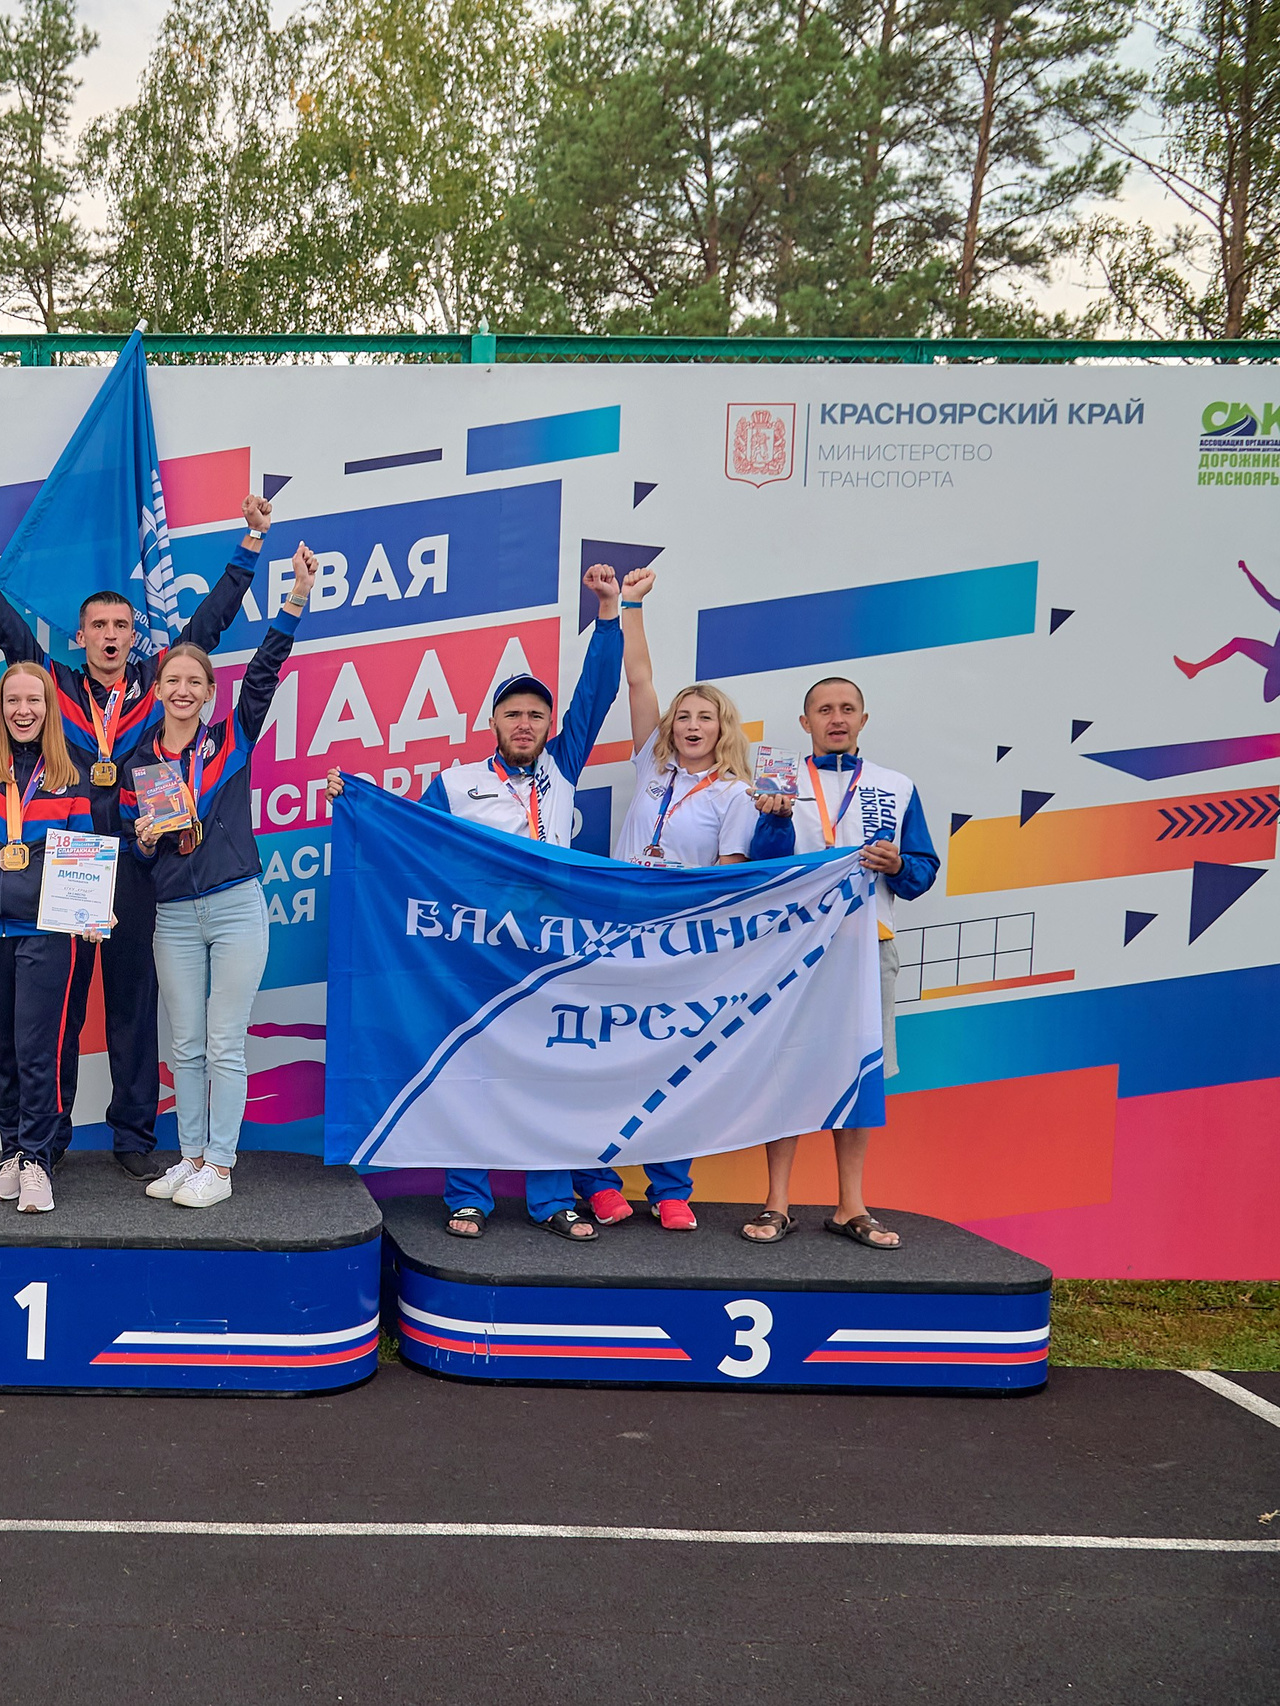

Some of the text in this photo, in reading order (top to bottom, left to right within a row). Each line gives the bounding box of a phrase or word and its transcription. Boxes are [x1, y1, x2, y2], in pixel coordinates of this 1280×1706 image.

[820, 398, 1145, 426] КРАСНОЯРСКИЙ КРАЙ
[818, 442, 993, 463] МИНИСТЕРСТВО
[818, 470, 955, 490] ТРАНСПОРТА
[56, 835, 71, 848] 18
[57, 869, 101, 883] ДИПЛОМ
[13, 1281, 49, 1361] 1
[716, 1299, 775, 1379] 3
